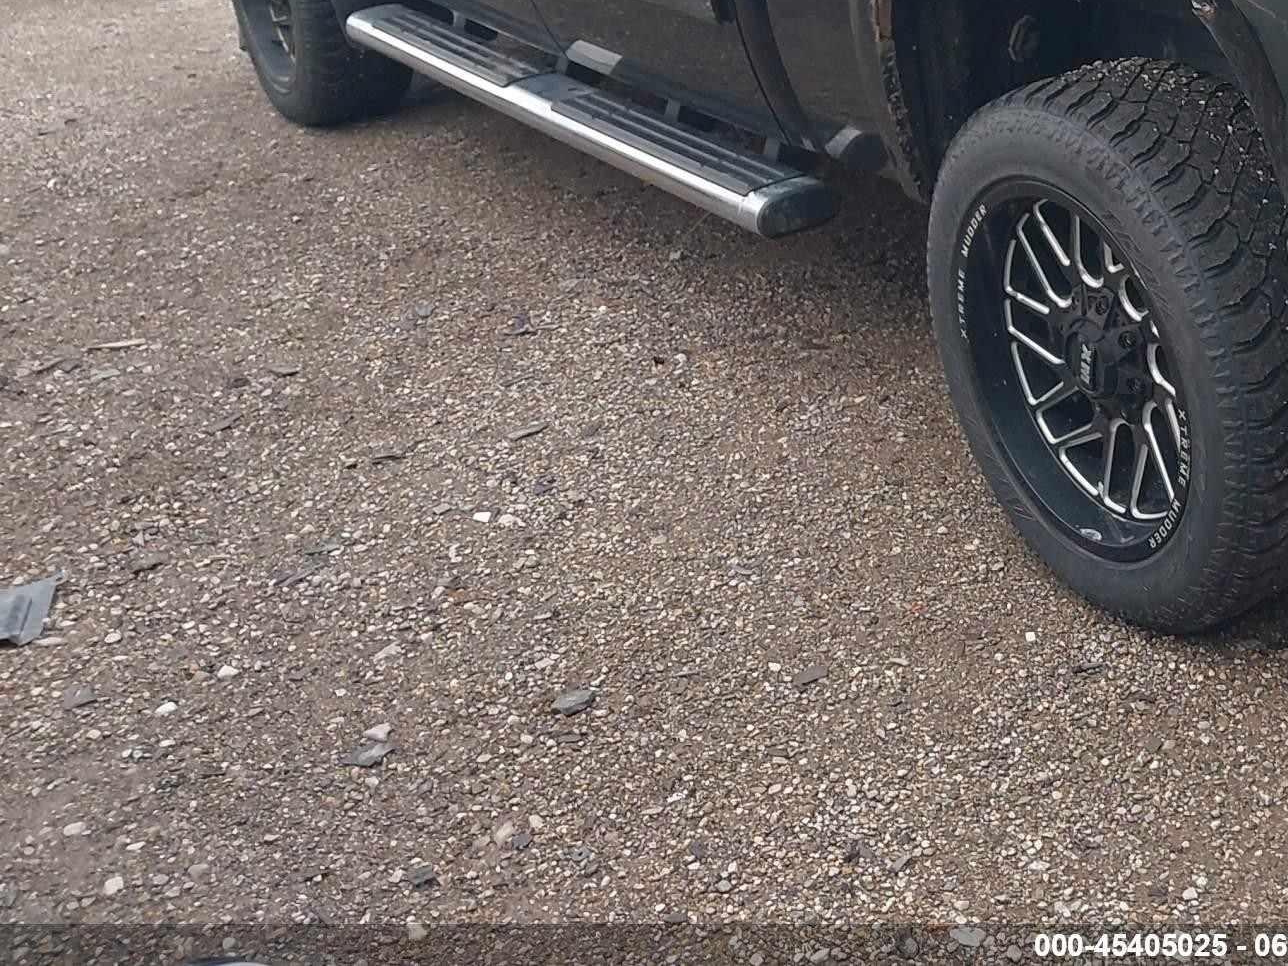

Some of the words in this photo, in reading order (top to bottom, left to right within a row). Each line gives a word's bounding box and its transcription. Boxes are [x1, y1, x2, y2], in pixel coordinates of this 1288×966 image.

[960, 204, 988, 259] MUDDER
[957, 267, 969, 340] XTREME
[1177, 407, 1191, 488] XTREME
[1148, 497, 1182, 550] MUDDER
